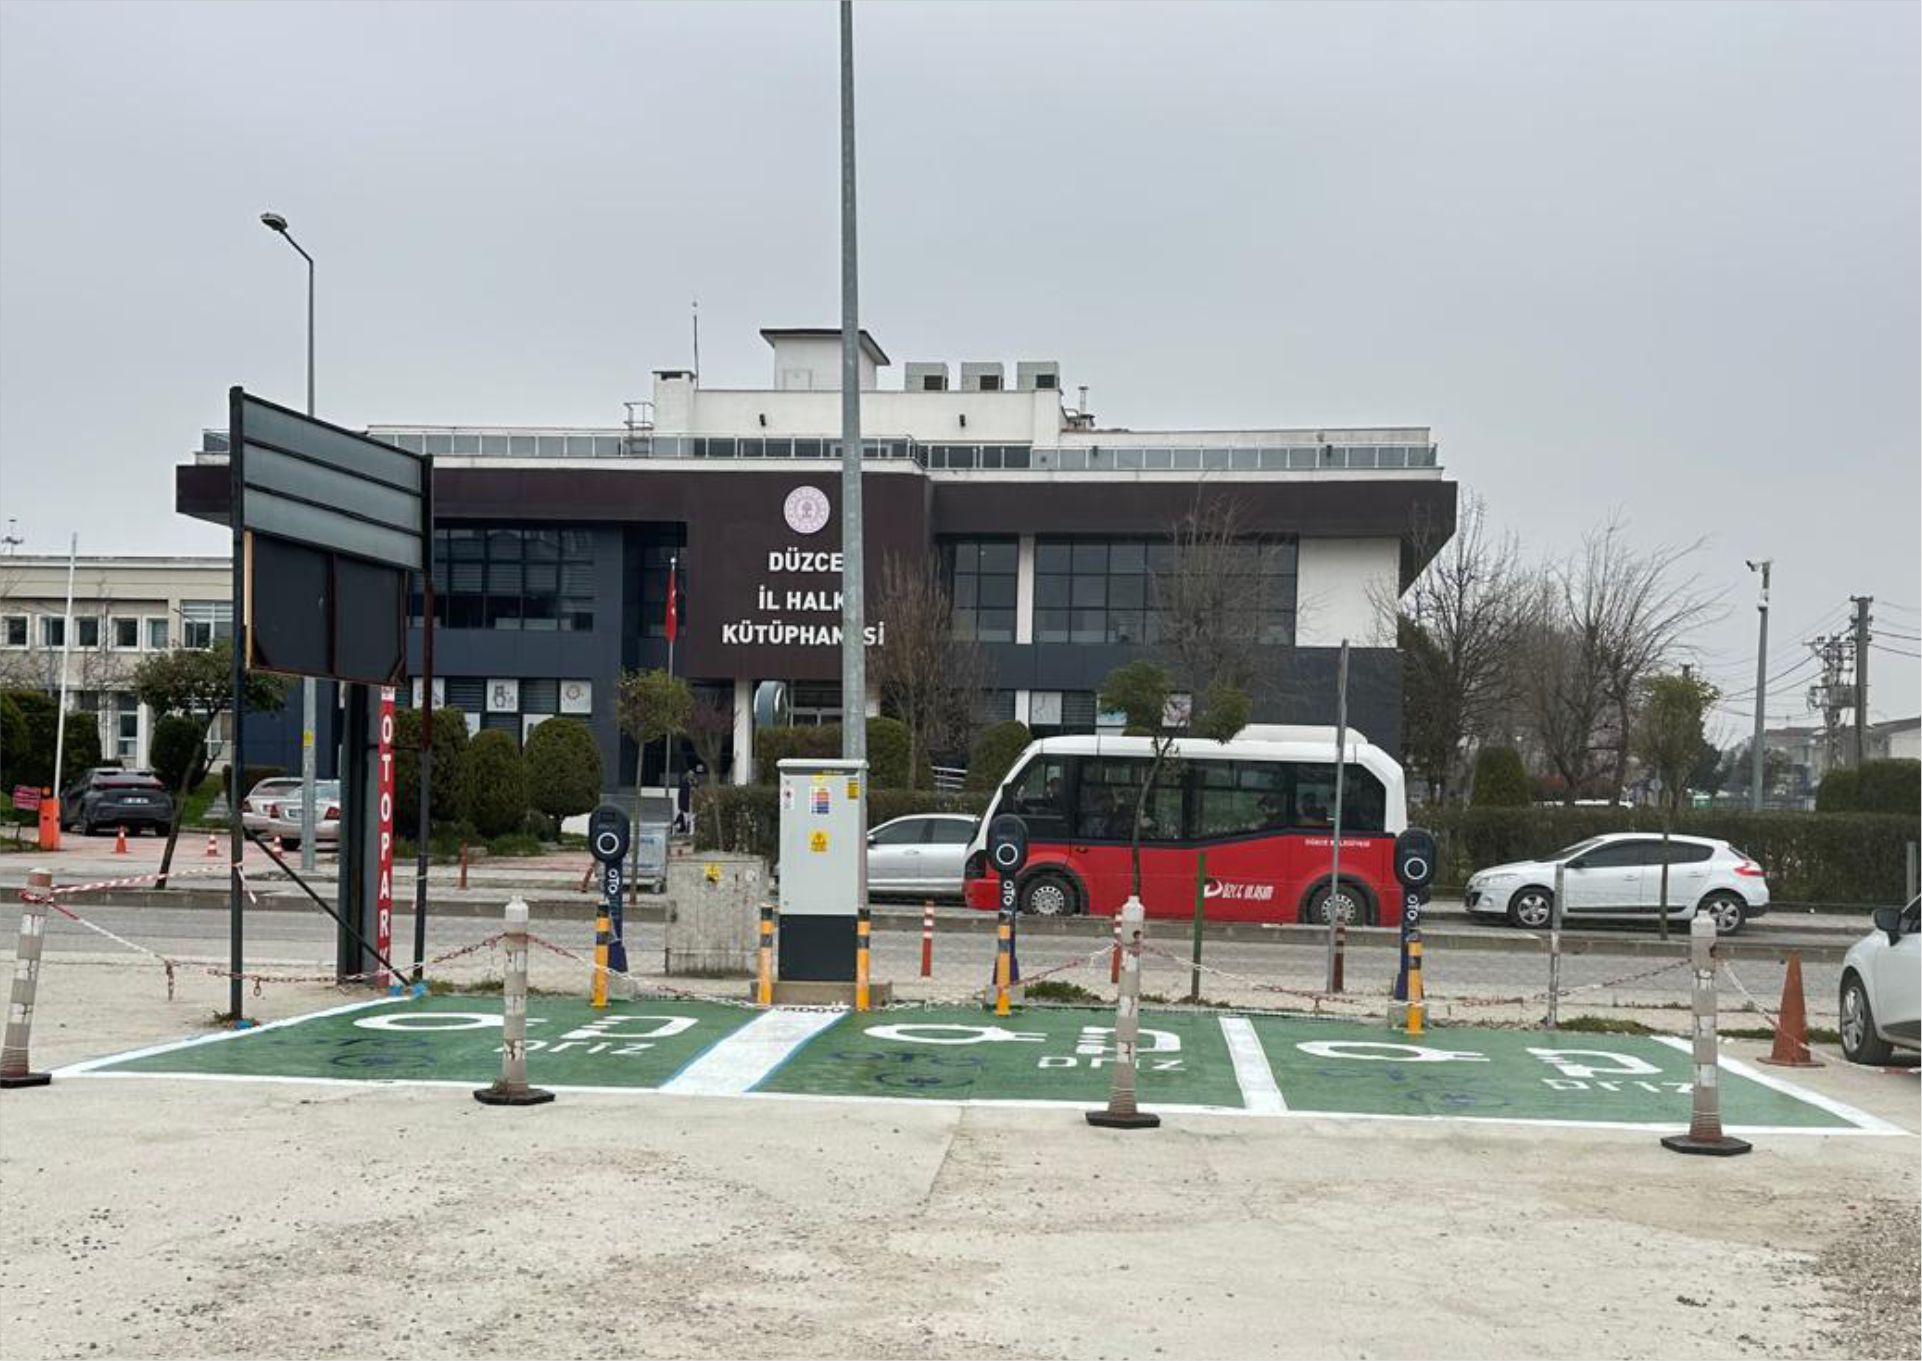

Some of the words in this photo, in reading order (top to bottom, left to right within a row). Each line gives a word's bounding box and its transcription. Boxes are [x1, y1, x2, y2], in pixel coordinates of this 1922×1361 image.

[768, 546, 843, 572] DÜZCE
[758, 585, 780, 610] İL
[722, 620, 885, 646] KÜTÜPHANSİ
